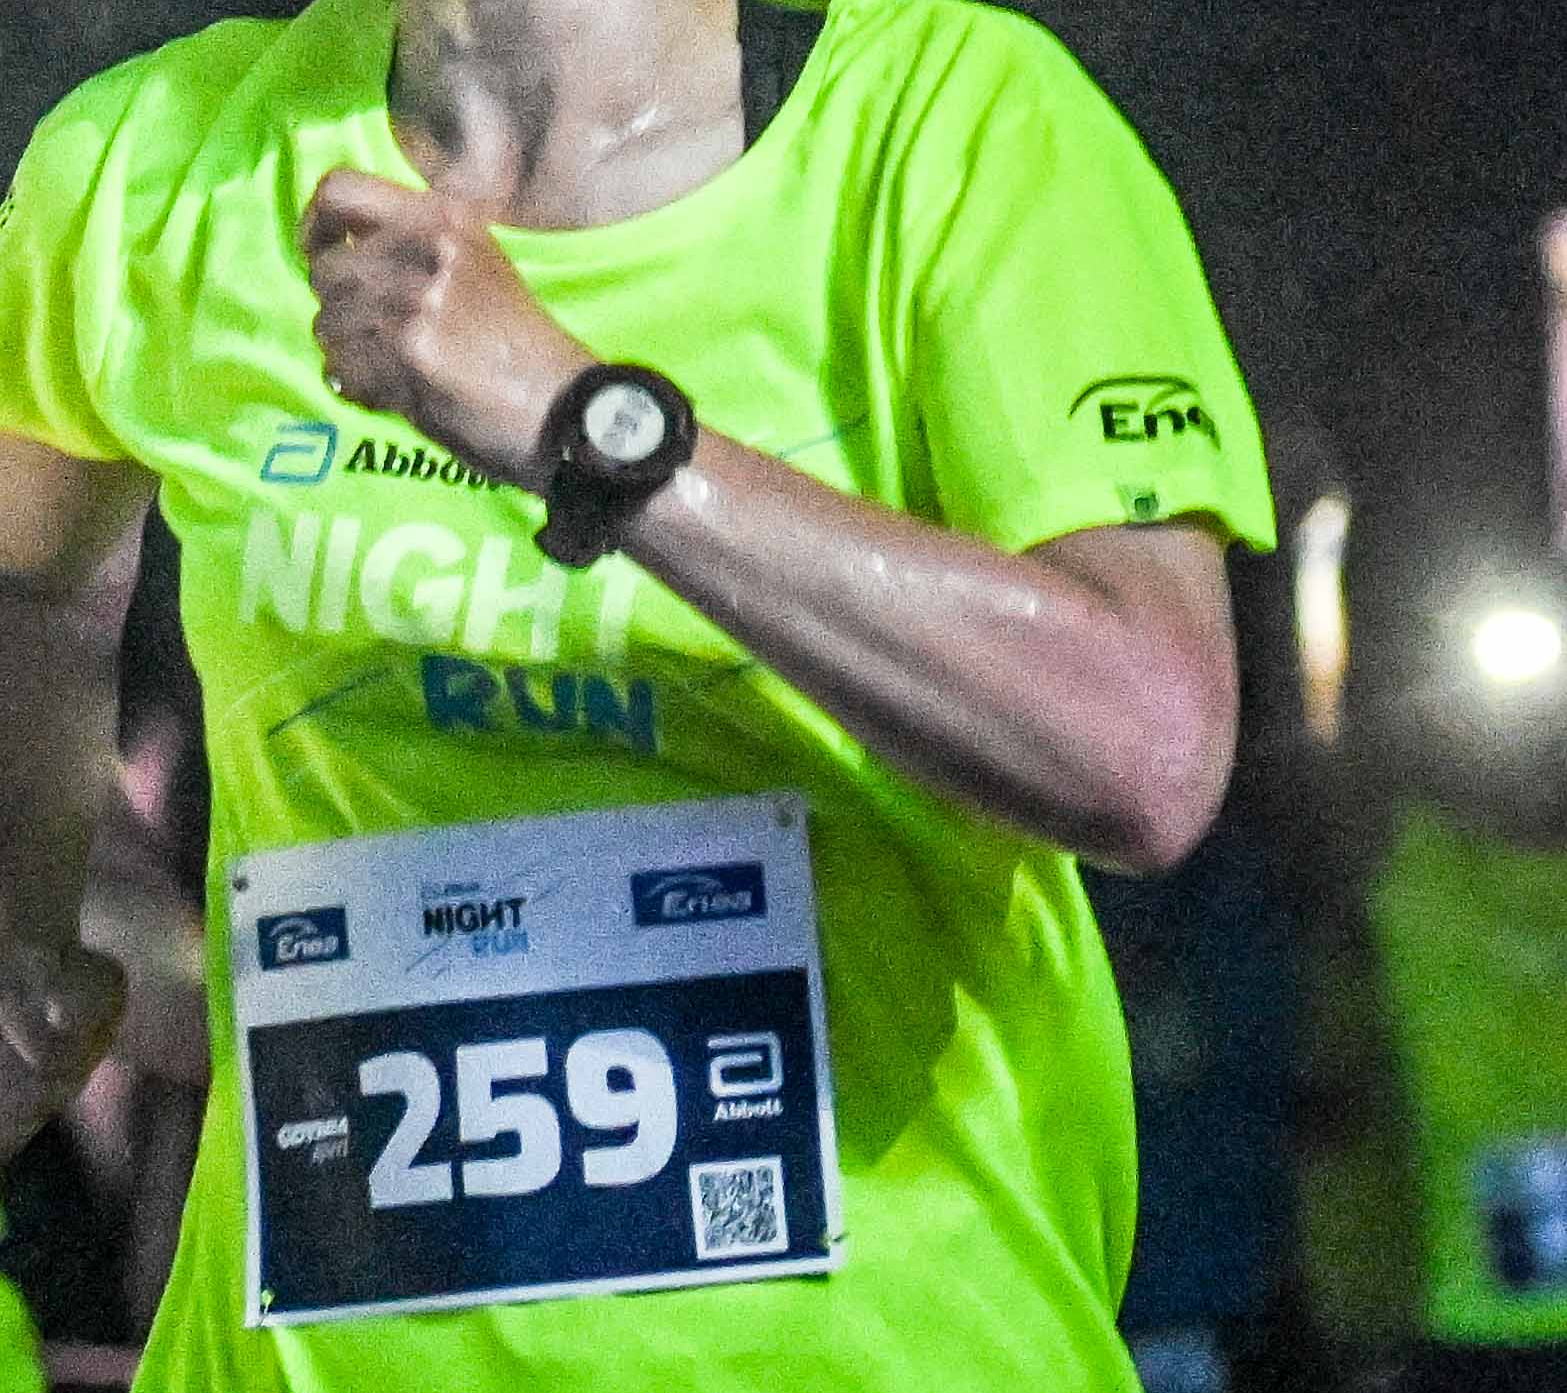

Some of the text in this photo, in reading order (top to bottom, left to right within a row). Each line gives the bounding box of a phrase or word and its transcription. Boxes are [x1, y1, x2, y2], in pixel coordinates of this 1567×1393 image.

[238, 511, 642, 665] NIGHT
[420, 652, 662, 757] RUN
[422, 897, 526, 935] NIGHT
[359, 1027, 678, 1208] 259
[713, 1097, 784, 1122] Abbott
